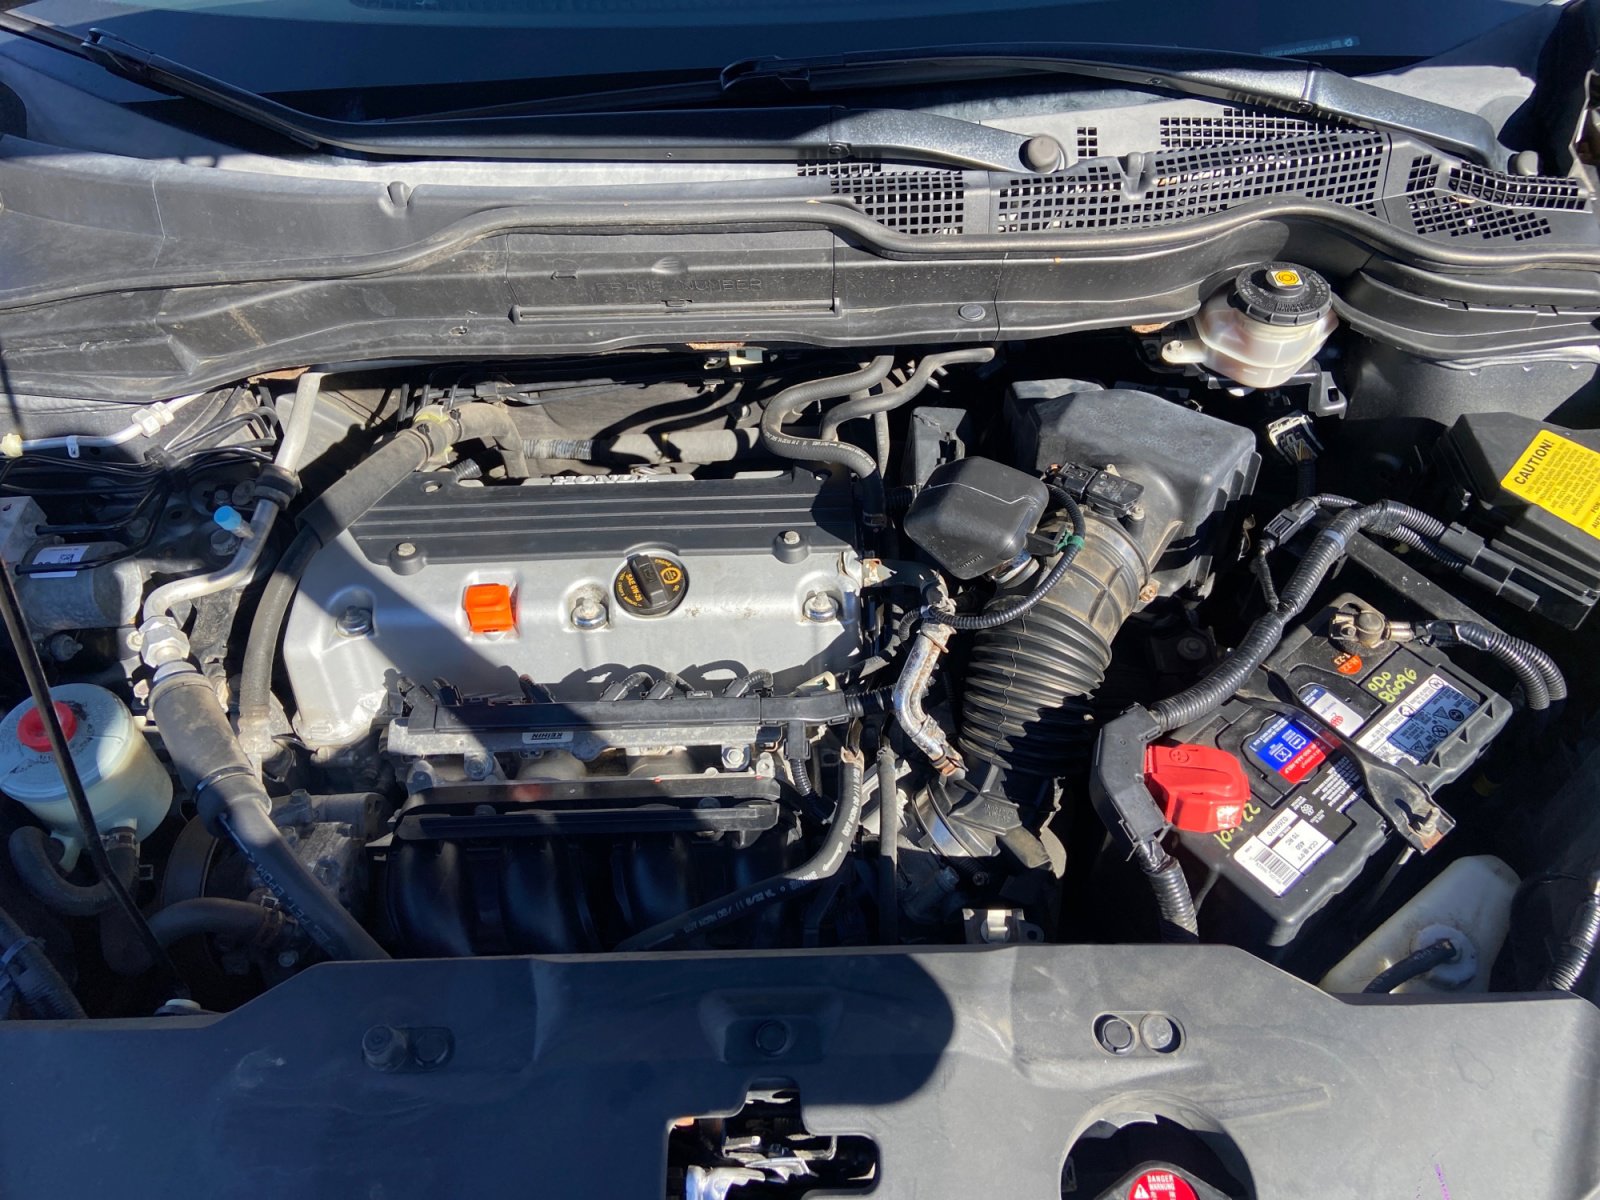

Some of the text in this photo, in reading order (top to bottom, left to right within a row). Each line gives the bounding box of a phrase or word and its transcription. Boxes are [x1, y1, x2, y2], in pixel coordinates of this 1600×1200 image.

[677, 279, 763, 291] NUMBER
[1513, 438, 1553, 485] CAUTION!
[1377, 667, 1418, 703] 86096
[531, 733, 564, 741] KEIHIN
[253, 862, 286, 897] EPDM
[1147, 1174, 1174, 1183] DANGER
